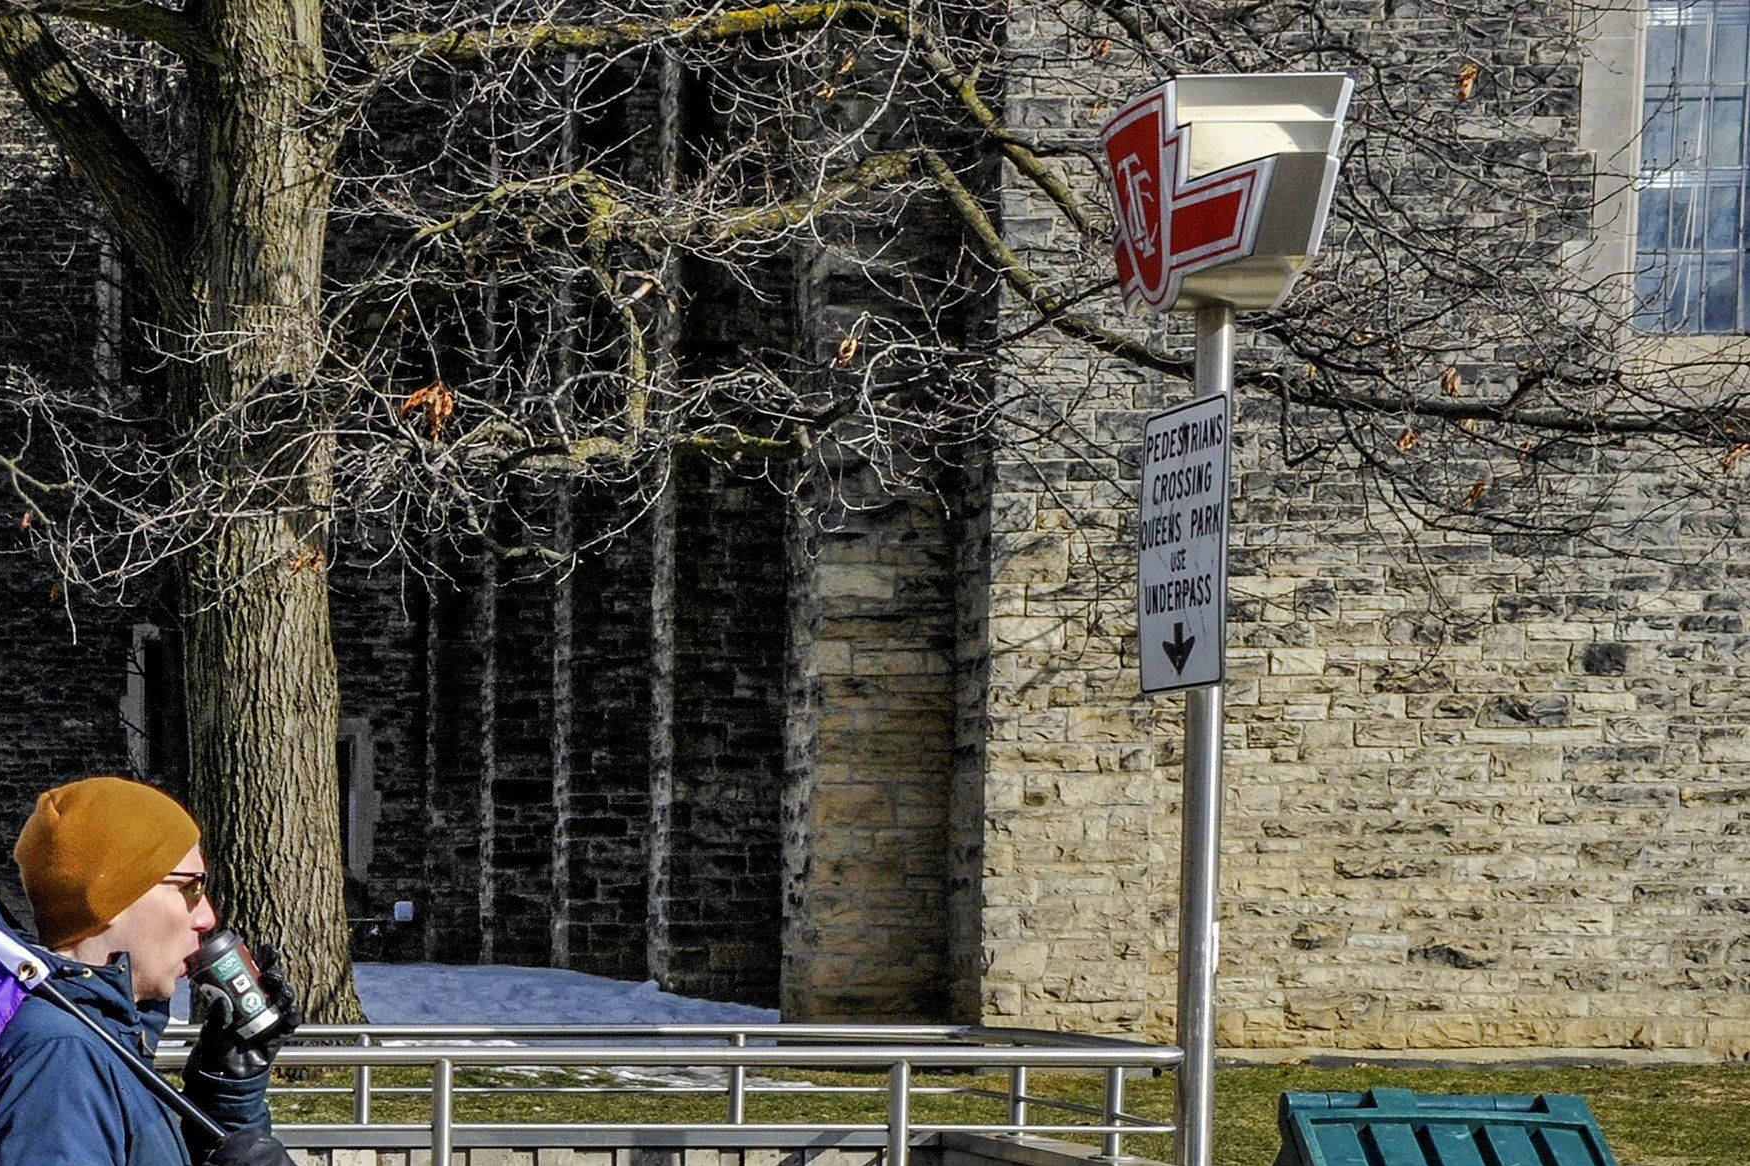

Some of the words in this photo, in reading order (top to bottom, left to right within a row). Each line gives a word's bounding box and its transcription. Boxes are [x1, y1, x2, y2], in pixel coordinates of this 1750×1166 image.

[1146, 413, 1223, 466] PEDESTRIANS
[1153, 461, 1212, 505] CROSSING
[1141, 512, 1181, 551] QUEENS
[1190, 503, 1220, 539] PARK
[1170, 548, 1186, 572] USE
[1144, 573, 1211, 615] UNDERPASS
